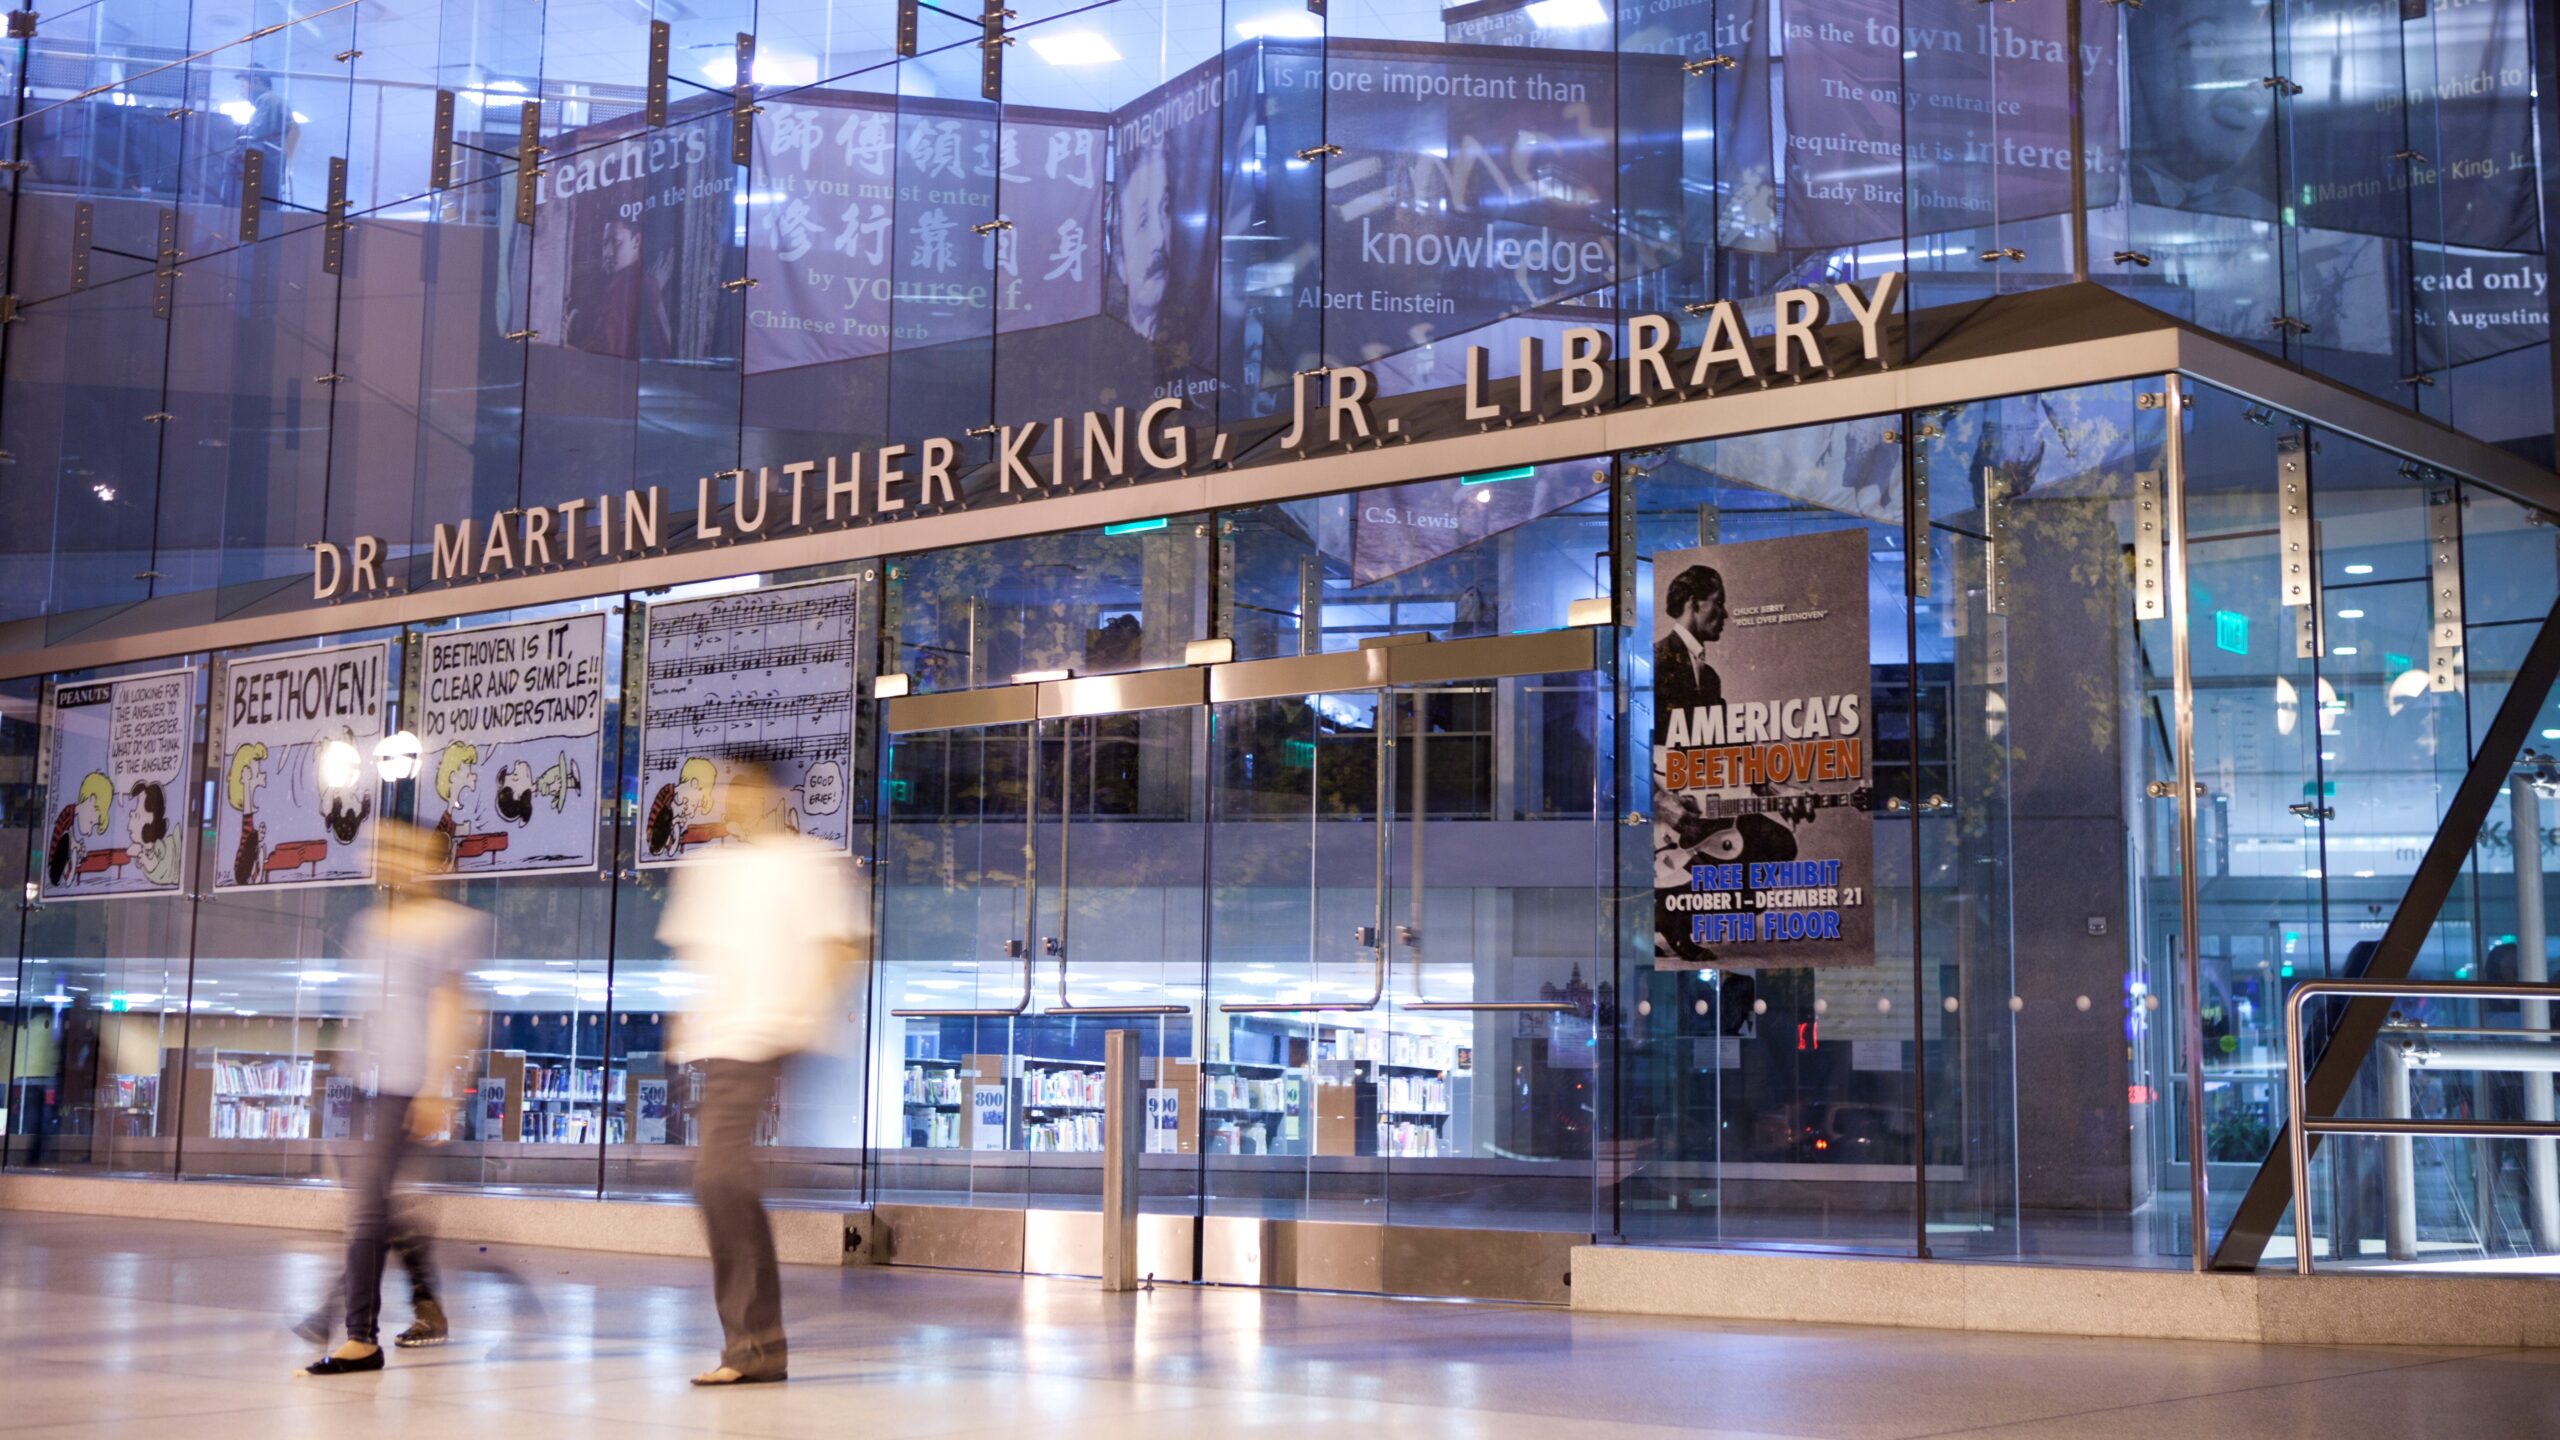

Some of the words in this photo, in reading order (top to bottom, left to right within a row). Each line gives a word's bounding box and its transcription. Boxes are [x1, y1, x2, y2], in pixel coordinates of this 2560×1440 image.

[1820, 24, 1854, 44] the
[1865, 17, 1963, 53] town
[1977, 25, 2114, 76] libray.
[1274, 64, 1294, 88] is
[1304, 69, 1373, 92] more
[1383, 67, 1517, 101] important
[1527, 75, 1586, 103] than
[1822, 79, 1863, 101] The
[1870, 88, 1921, 112] ony
[1929, 93, 2021, 115] entrance
[2430, 71, 2494, 101] which
[2500, 67, 2522, 87] to
[1116, 69, 1239, 157] imagination
[1788, 132, 1928, 159] requirement
[1936, 141, 1953, 161] is
[756, 169, 796, 191] but
[803, 177, 850, 200] you
[859, 181, 920, 202] must
[929, 186, 991, 207] enter
[1806, 180, 1857, 206] Lady
[1911, 188, 1995, 212] Johnson
[2319, 176, 2382, 202] Martin
[2452, 156, 2500, 181] King,
[619, 194, 656, 221] opn
[664, 186, 686, 207] the
[1362, 217, 1616, 285] knowledge.
[808, 268, 834, 292] by
[844, 276, 1033, 312] yoursef.
[2483, 266, 2548, 296] only
[1298, 287, 1363, 312] Albert
[1371, 290, 1455, 315] Einstein
[749, 309, 836, 335] Chinese
[843, 318, 928, 341] Proverb
[1154, 378, 1183, 399] old
[313, 534, 397, 600] DR.
[431, 484, 664, 582] MARTIN
[696, 436, 960, 542] LUTHER
[1000, 396, 1230, 494] KING,
[1281, 365, 1400, 450] JR.
[1464, 271, 1906, 421] LIBRARY
[1365, 506, 1401, 525] C.S.
[1406, 510, 1459, 530] Lewis
[432, 638, 516, 674] BEETHOVEN
[522, 634, 541, 661] IS
[547, 623, 574, 661] IT,
[131, 684, 163, 703] LOOKING
[165, 682, 180, 699] FOR
[232, 655, 379, 729] BEETHOVEN!
[431, 672, 483, 703] CLEAR
[486, 668, 520, 699] AND
[523, 655, 600, 693] SIMPLE!!
[60, 687, 110, 706] PEANUTS
[115, 706, 130, 722] THE
[132, 702, 165, 720] ANSWER
[167, 701, 177, 715] TO
[426, 710, 445, 737] DO
[450, 706, 479, 733] YOU
[482, 690, 599, 731] UNDERSTAND?
[1665, 693, 1861, 749] AMERICA'S
[112, 741, 131, 757] WHAT
[133, 740, 143, 755] DO
[144, 739, 157, 754] YOU
[158, 737, 180, 754] THINK
[1665, 737, 1861, 790] BEETHOVEN
[115, 760, 123, 776] IS
[125, 759, 140, 774] THE
[141, 755, 179, 772] ANSWER?
[809, 775, 834, 788] GOOD
[1691, 863, 1744, 892] FREE
[1749, 858, 1841, 890] EXHIBIT
[1665, 891, 1732, 912] OCTOBER
[1842, 887, 1863, 906] 21
[1691, 912, 1755, 943] FIFTH
[1763, 910, 1841, 940] FLOOR
[639, 1086, 666, 1101] 500
[975, 1092, 1004, 1107] 800
